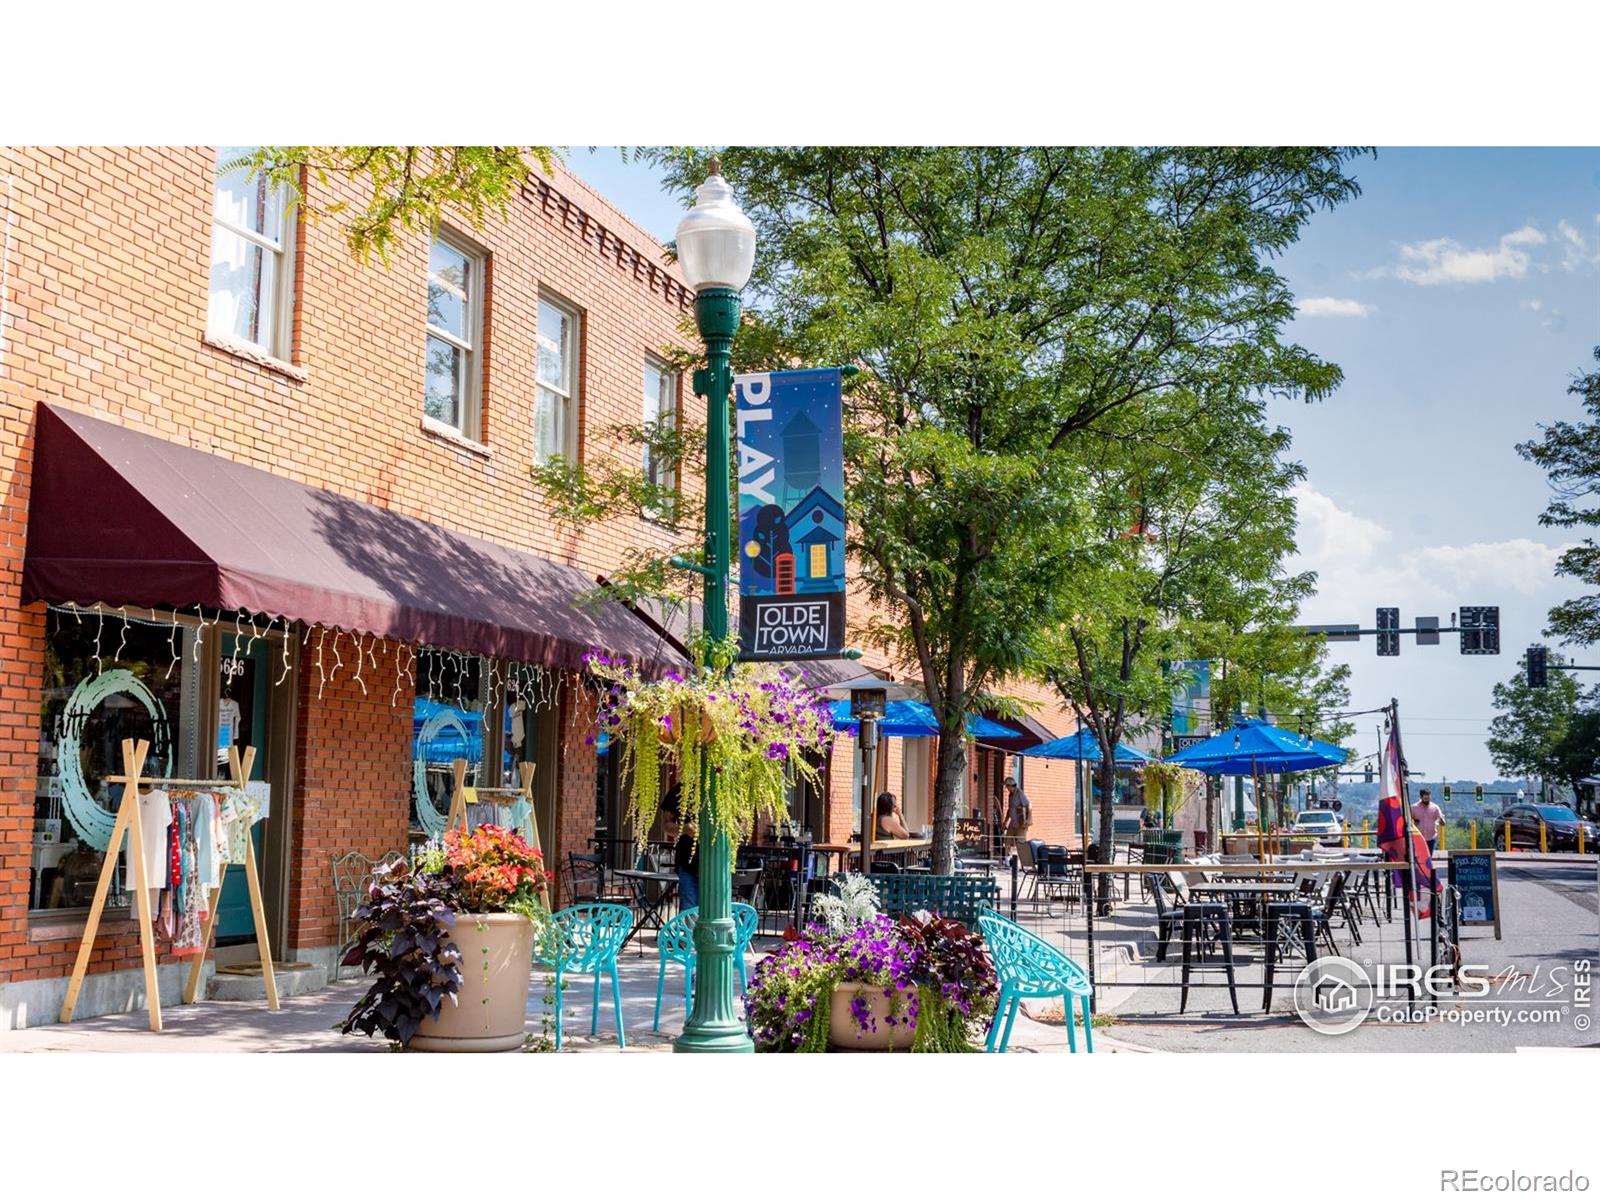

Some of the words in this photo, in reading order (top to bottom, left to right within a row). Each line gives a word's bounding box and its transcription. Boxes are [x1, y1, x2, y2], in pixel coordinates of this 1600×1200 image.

[735, 373, 776, 503] PLAY
[764, 606, 821, 626] OLDE
[760, 625, 824, 645] TOWN
[768, 645, 813, 655] ARVADA
